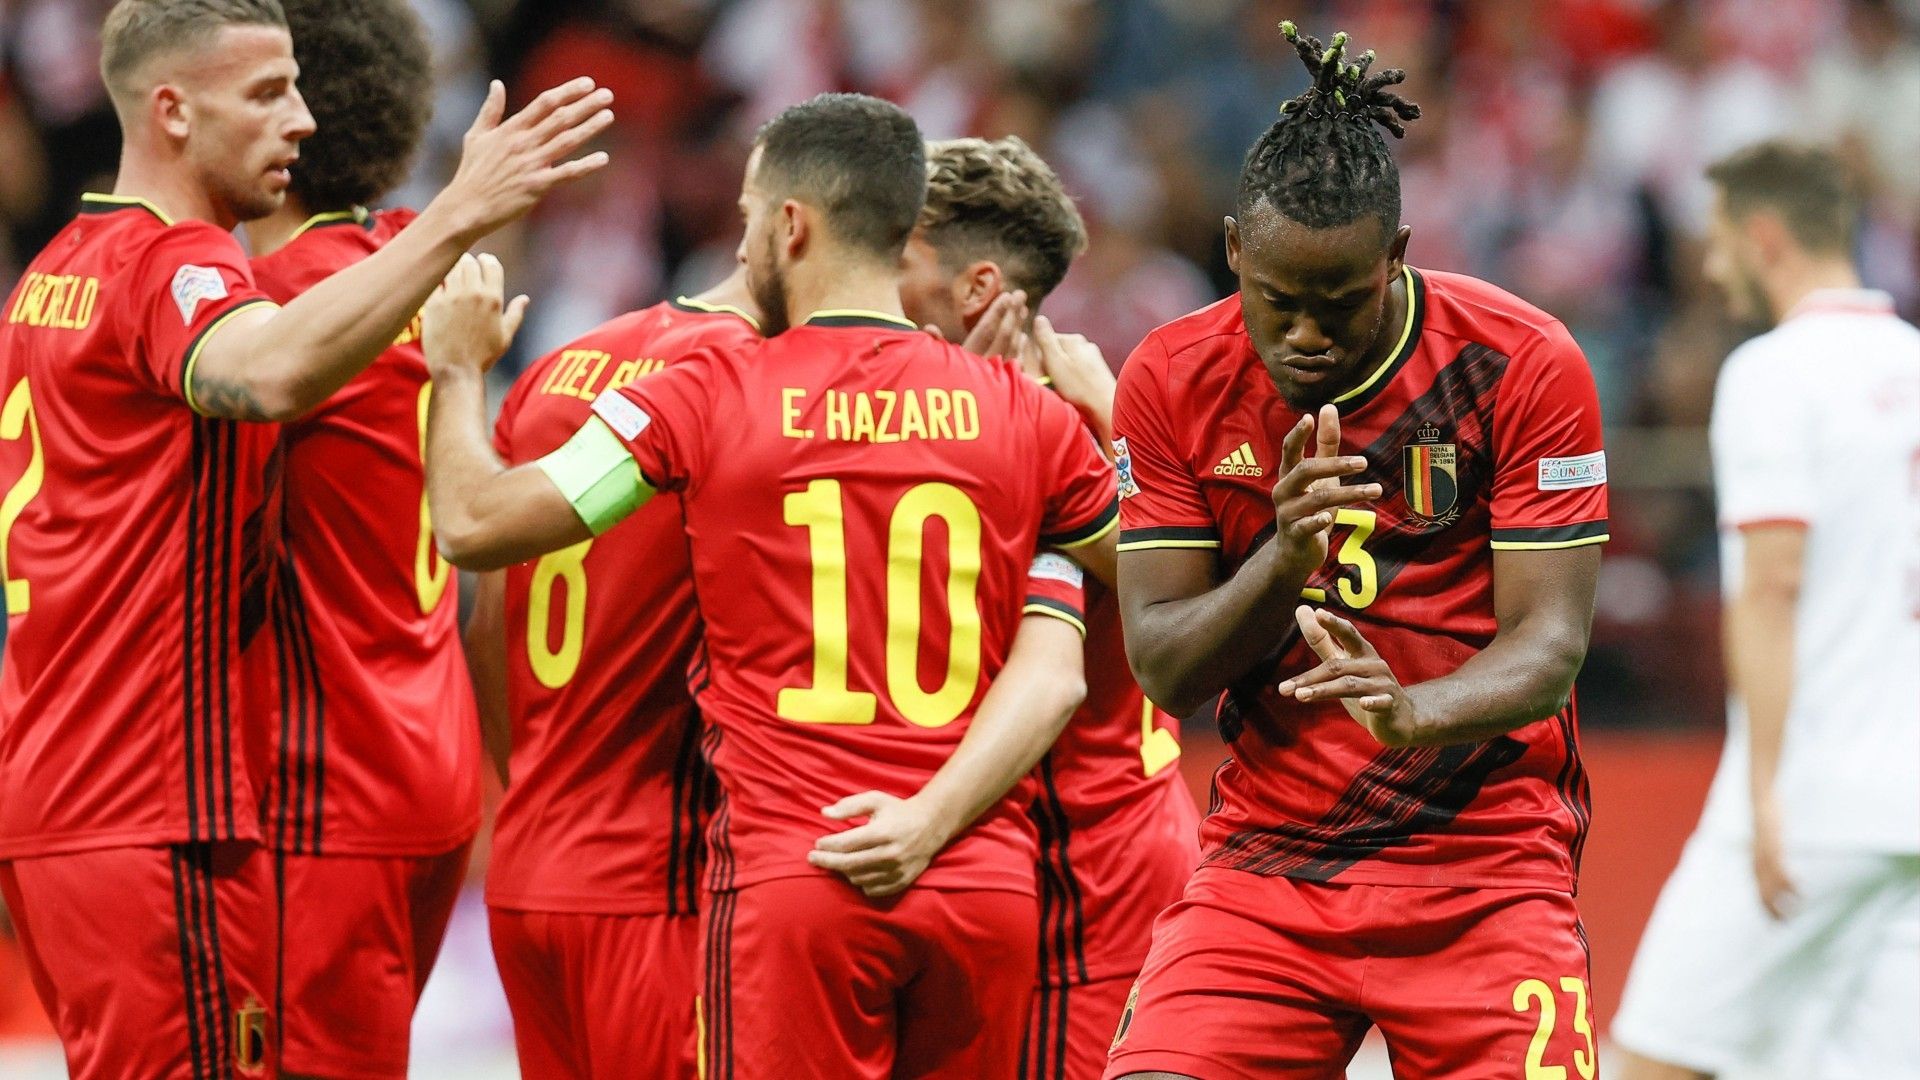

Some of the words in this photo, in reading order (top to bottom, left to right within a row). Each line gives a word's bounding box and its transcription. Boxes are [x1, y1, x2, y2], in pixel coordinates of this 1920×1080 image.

[782, 388, 815, 440] E.
[826, 388, 981, 443] HAZARD
[1213, 463, 1263, 477] adidas
[1541, 459, 1562, 468] UEFA
[777, 478, 982, 728] 10
[1512, 976, 1596, 1080] 23
